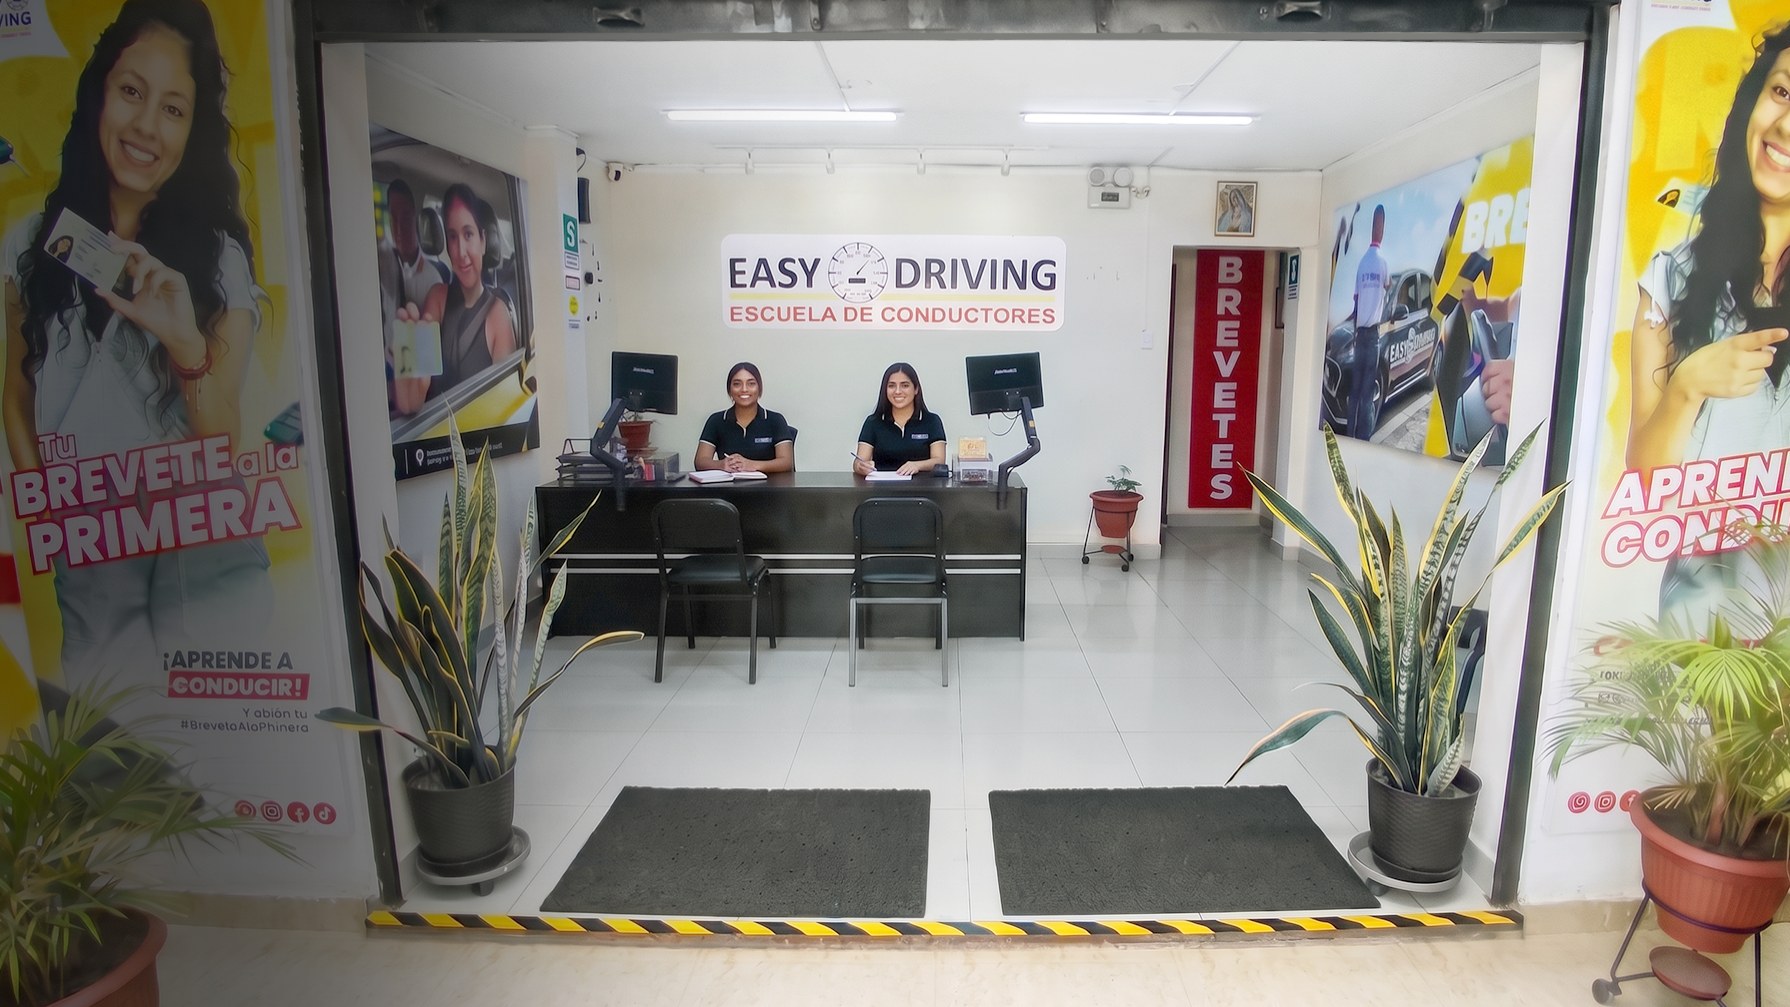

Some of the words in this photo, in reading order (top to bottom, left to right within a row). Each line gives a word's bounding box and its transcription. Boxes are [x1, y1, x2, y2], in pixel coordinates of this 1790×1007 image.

[566, 220, 576, 248] S
[728, 257, 821, 289] EASY
[895, 258, 1057, 291] DRIVING
[729, 305, 836, 322] ESCUELA
[843, 306, 873, 323] DE
[881, 307, 1056, 325] CONDUCTORES
[1209, 255, 1243, 500] BREVETES
[39, 433, 77, 462] Tu
[11, 434, 233, 518] BREVETE
[236, 451, 260, 477] a
[265, 441, 299, 473] la
[27, 477, 302, 574] PRIMERA
[163, 650, 271, 671] ¡APRENDE
[277, 652, 293, 670] A
[172, 677, 302, 697] CONDUCIR!
[242, 708, 250, 718] Y
[294, 709, 308, 719] tu
